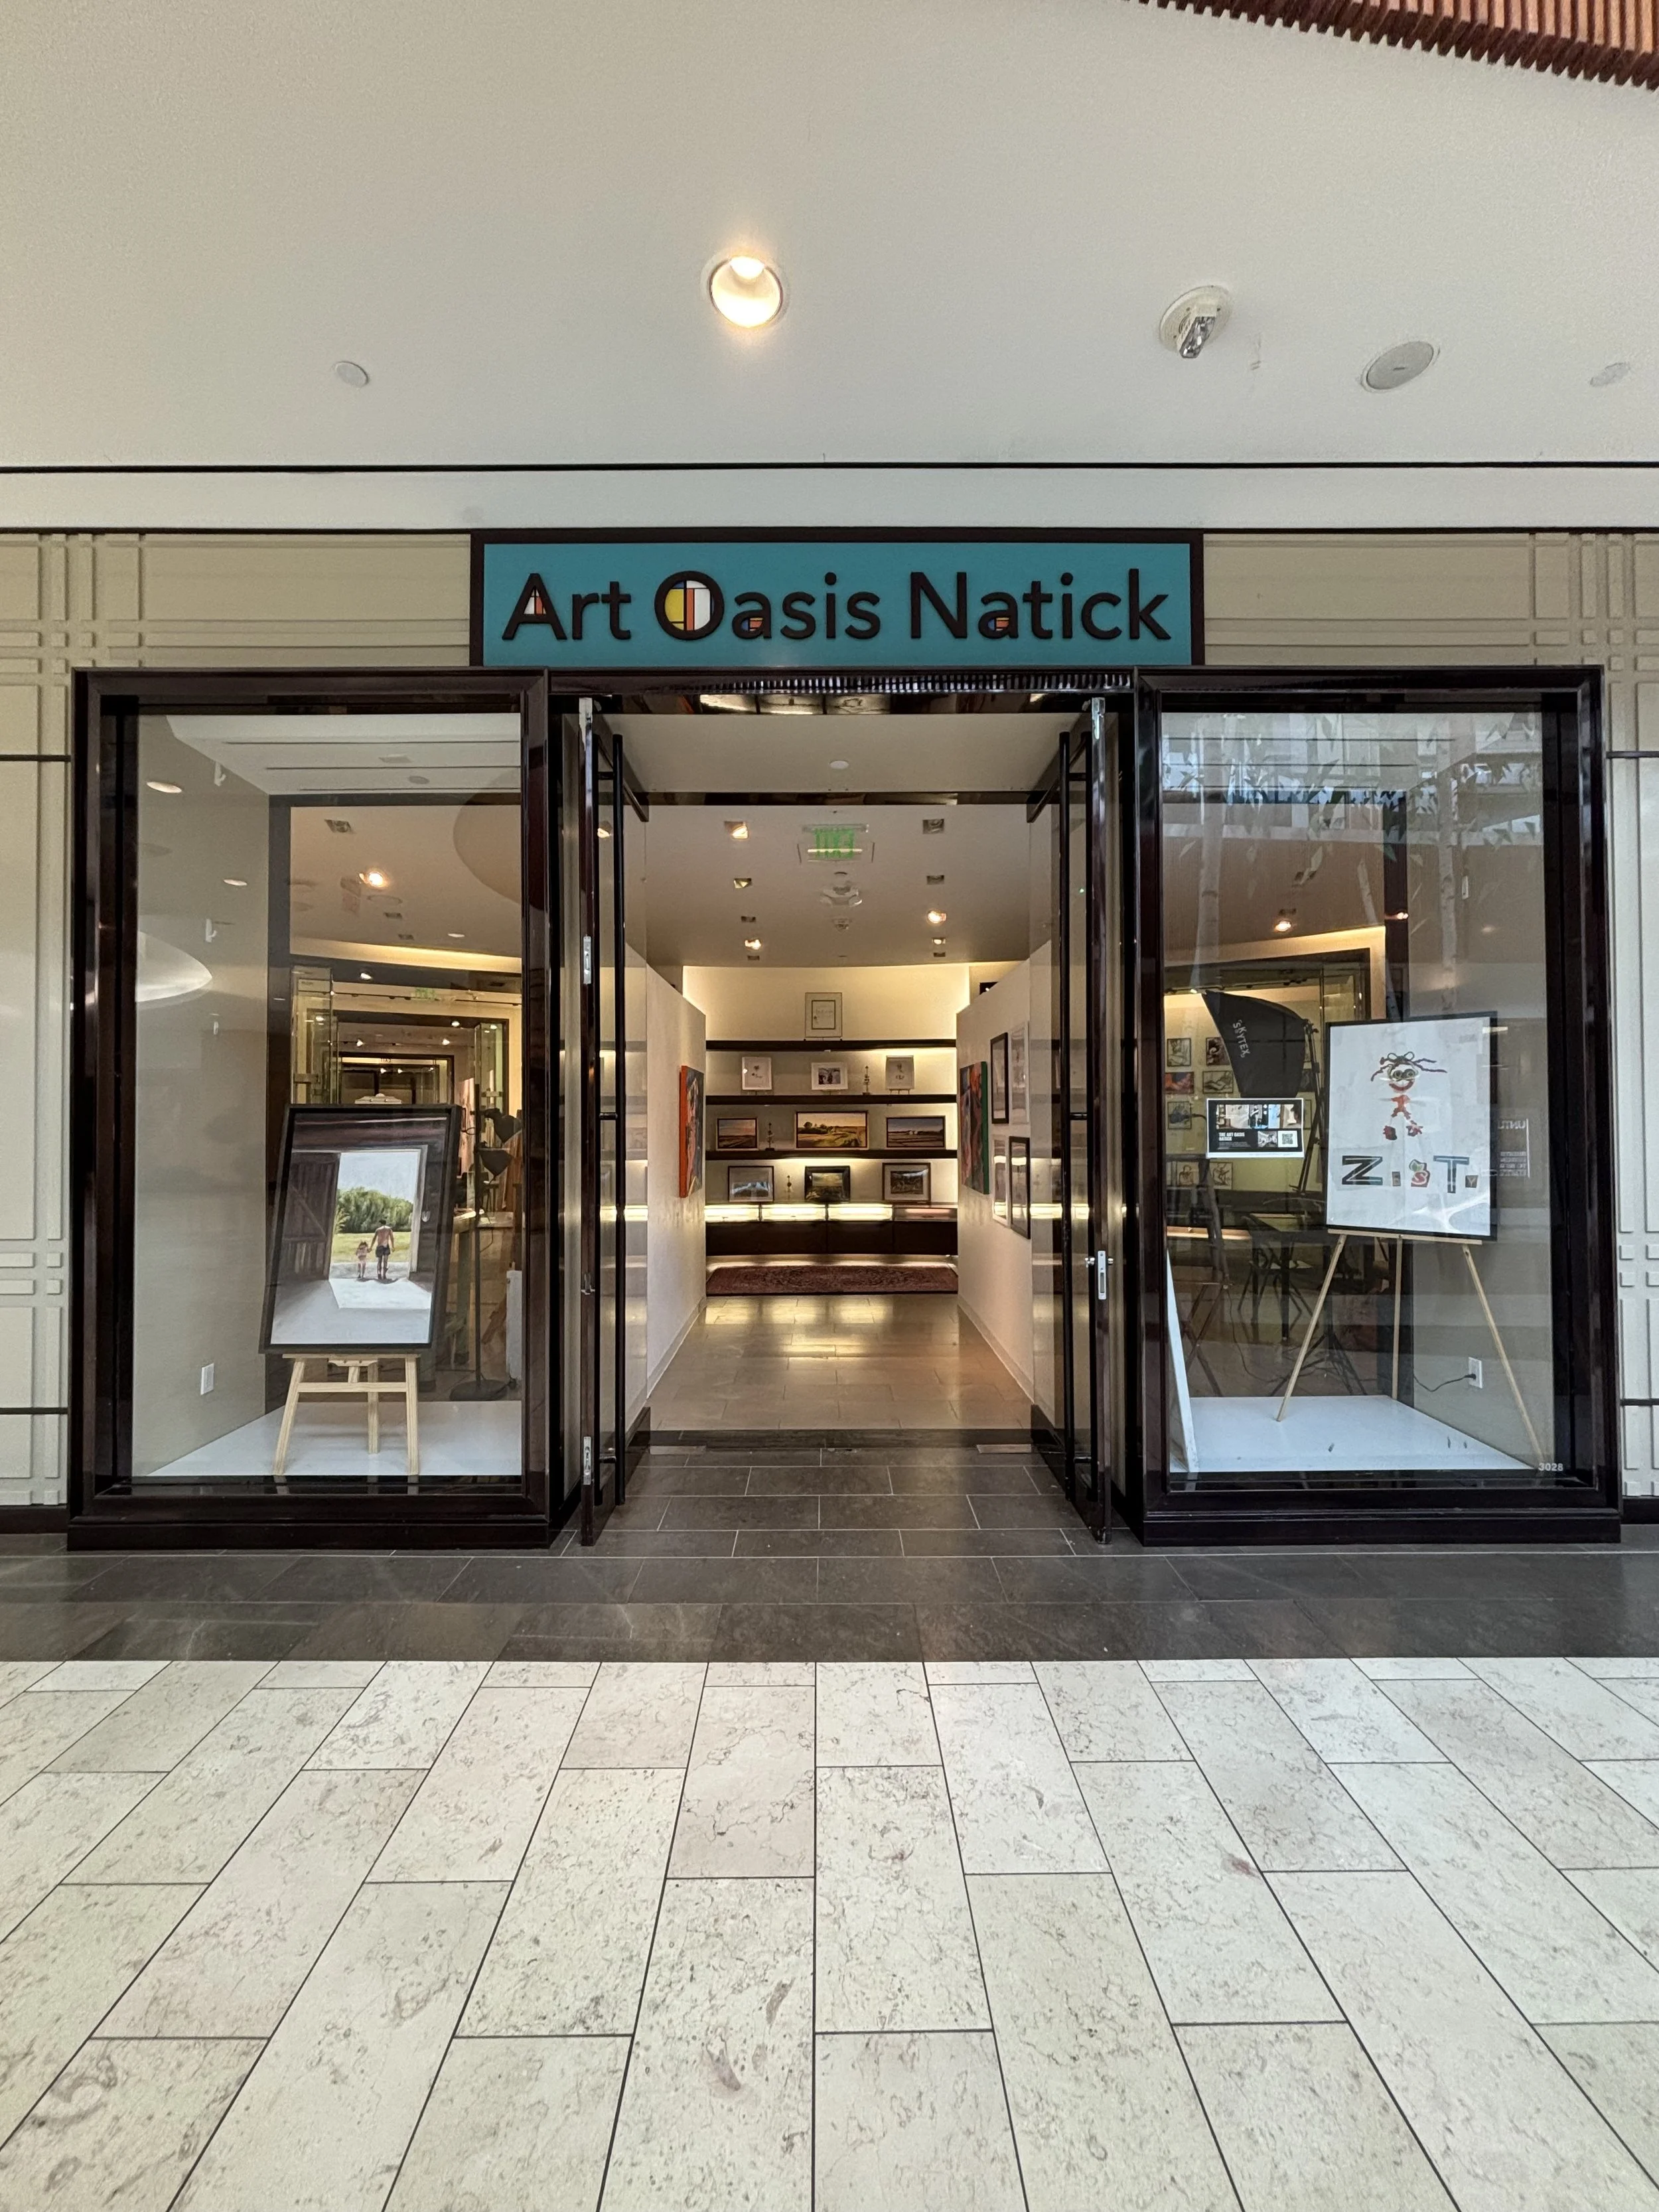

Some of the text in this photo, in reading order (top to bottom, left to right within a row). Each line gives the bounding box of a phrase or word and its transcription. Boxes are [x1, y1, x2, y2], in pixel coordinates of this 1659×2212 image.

[502, 568, 1172, 641] Art Oasis Natick
[1232, 1021, 1251, 1057] SKYTEX
[1538, 1463, 1564, 1471] 3028
